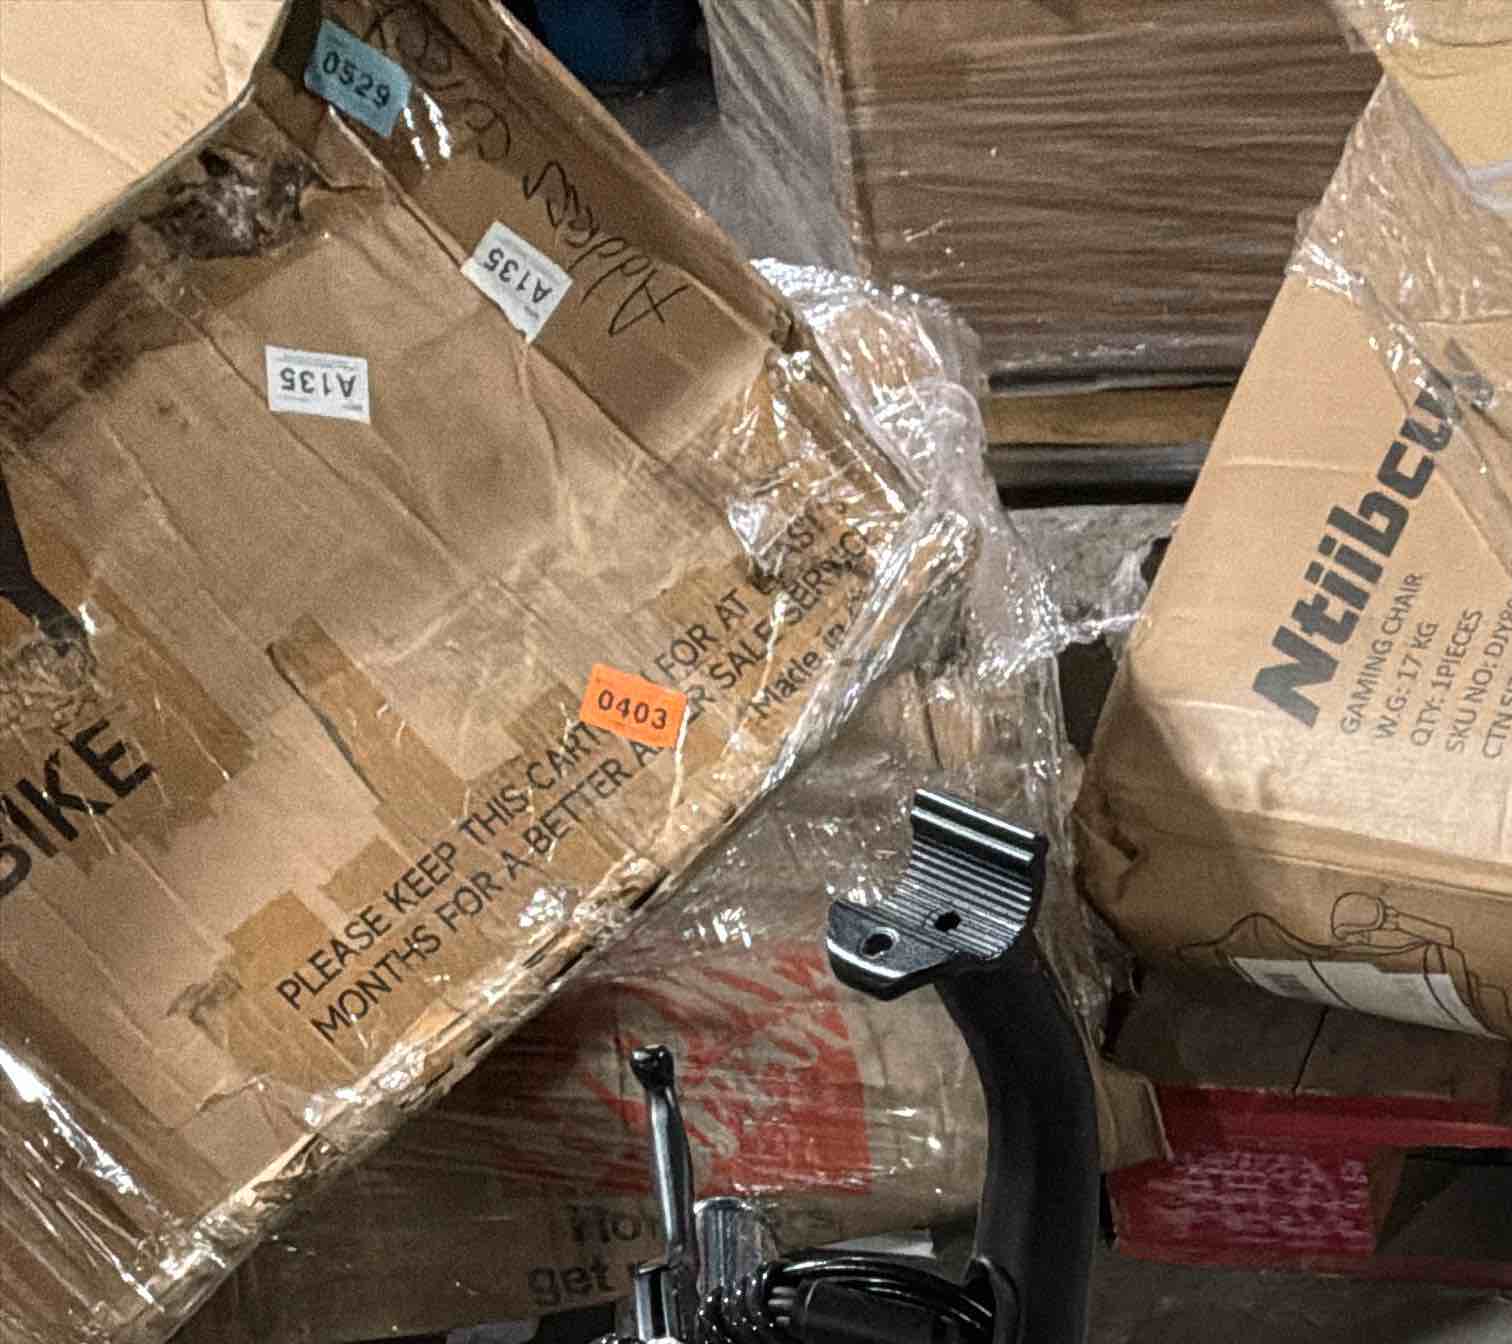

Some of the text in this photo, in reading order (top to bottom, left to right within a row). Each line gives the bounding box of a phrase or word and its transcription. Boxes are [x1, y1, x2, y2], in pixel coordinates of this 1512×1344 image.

[323, 51, 390, 109] 0529
[482, 246, 553, 304] A135
[279, 366, 357, 398] A135
[748, 649, 825, 720] Made
[1340, 572, 1424, 735] GAMING CHAIR
[1397, 653, 1422, 682] 17
[1410, 621, 1439, 650] KG
[1410, 607, 1484, 748] QTY: 1PIECES
[596, 687, 669, 732] 0403
[1446, 706, 1477, 754] SKU
[1464, 659, 1498, 704] NO:
[275, 904, 393, 1011] PLEASE
[383, 840, 458, 914] KEEP
[458, 782, 532, 846] THIS
[654, 622, 721, 681] FOR
[714, 587, 750, 632] AT
[309, 923, 442, 1045] MONTHS
[434, 870, 504, 933] FOR
[502, 848, 532, 882] A
[522, 755, 634, 857] BETTER
[527, 1255, 619, 1305] get
